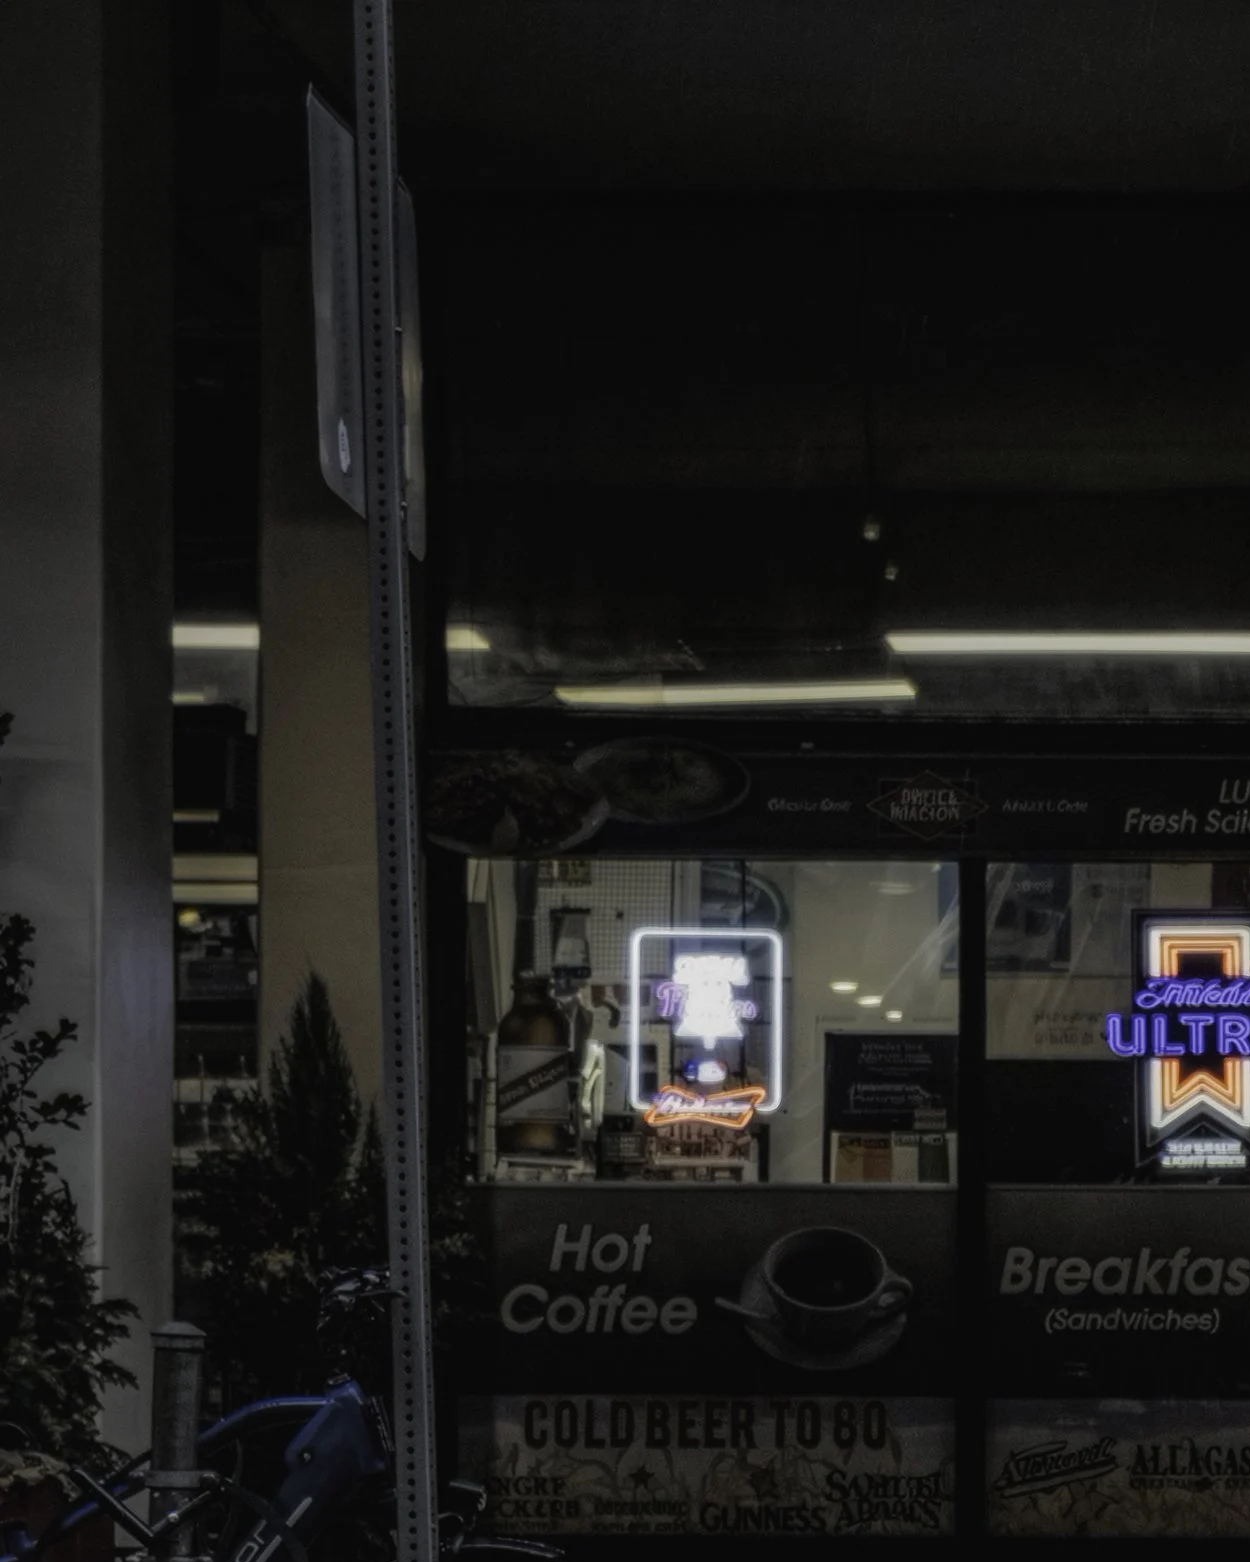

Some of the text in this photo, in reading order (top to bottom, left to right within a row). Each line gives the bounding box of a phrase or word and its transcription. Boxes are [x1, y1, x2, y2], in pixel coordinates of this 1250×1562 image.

[1123, 808, 1199, 834] Fresh
[549, 1223, 653, 1273] Hot
[501, 1283, 699, 1335] Coffee
[1044, 1308, 1221, 1334] (Sandwiches)
[524, 1400, 636, 1450] COLD
[645, 1400, 758, 1450] BEER
[768, 1400, 822, 1450] TO
